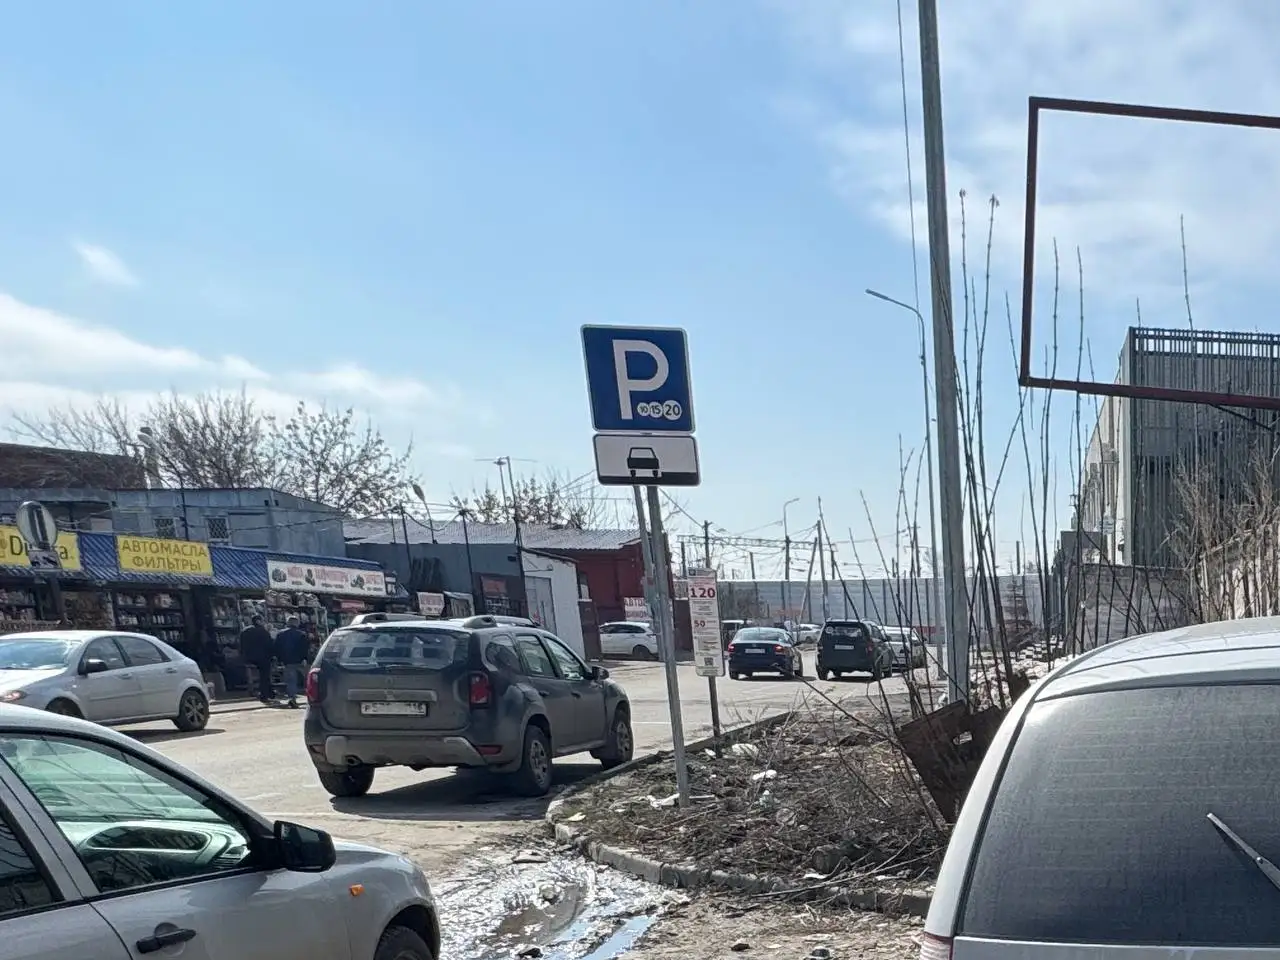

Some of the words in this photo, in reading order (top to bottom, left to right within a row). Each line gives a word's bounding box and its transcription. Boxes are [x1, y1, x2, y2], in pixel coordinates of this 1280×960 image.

[612, 339, 669, 420] P
[651, 404, 662, 415] 15
[664, 403, 681, 416] 20
[121, 539, 208, 557] АВТОМАСЛА
[131, 556, 202, 571] ФИЛЬТРЫ
